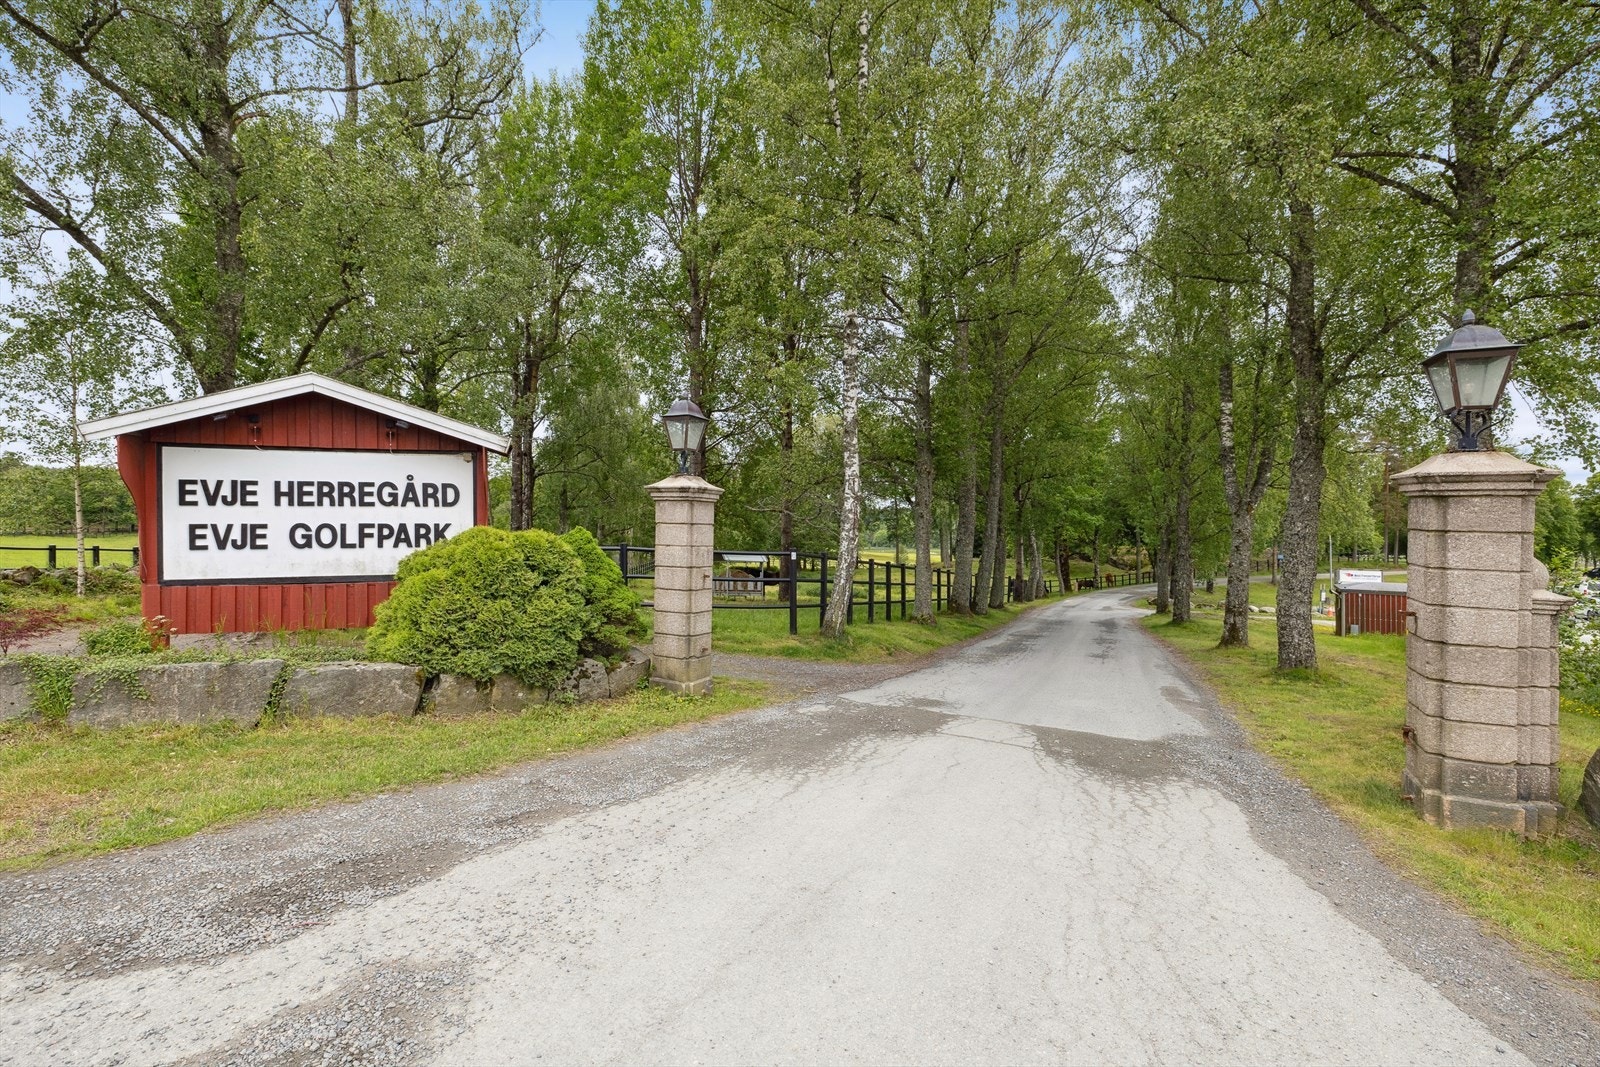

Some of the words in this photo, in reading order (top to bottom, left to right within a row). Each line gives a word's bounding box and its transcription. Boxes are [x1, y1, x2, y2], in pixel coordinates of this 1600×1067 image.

[178, 479, 259, 507] EVJE
[274, 474, 460, 508] HERREGÅRD
[188, 523, 268, 551] EVJE
[289, 522, 452, 549] GOLFPARK
